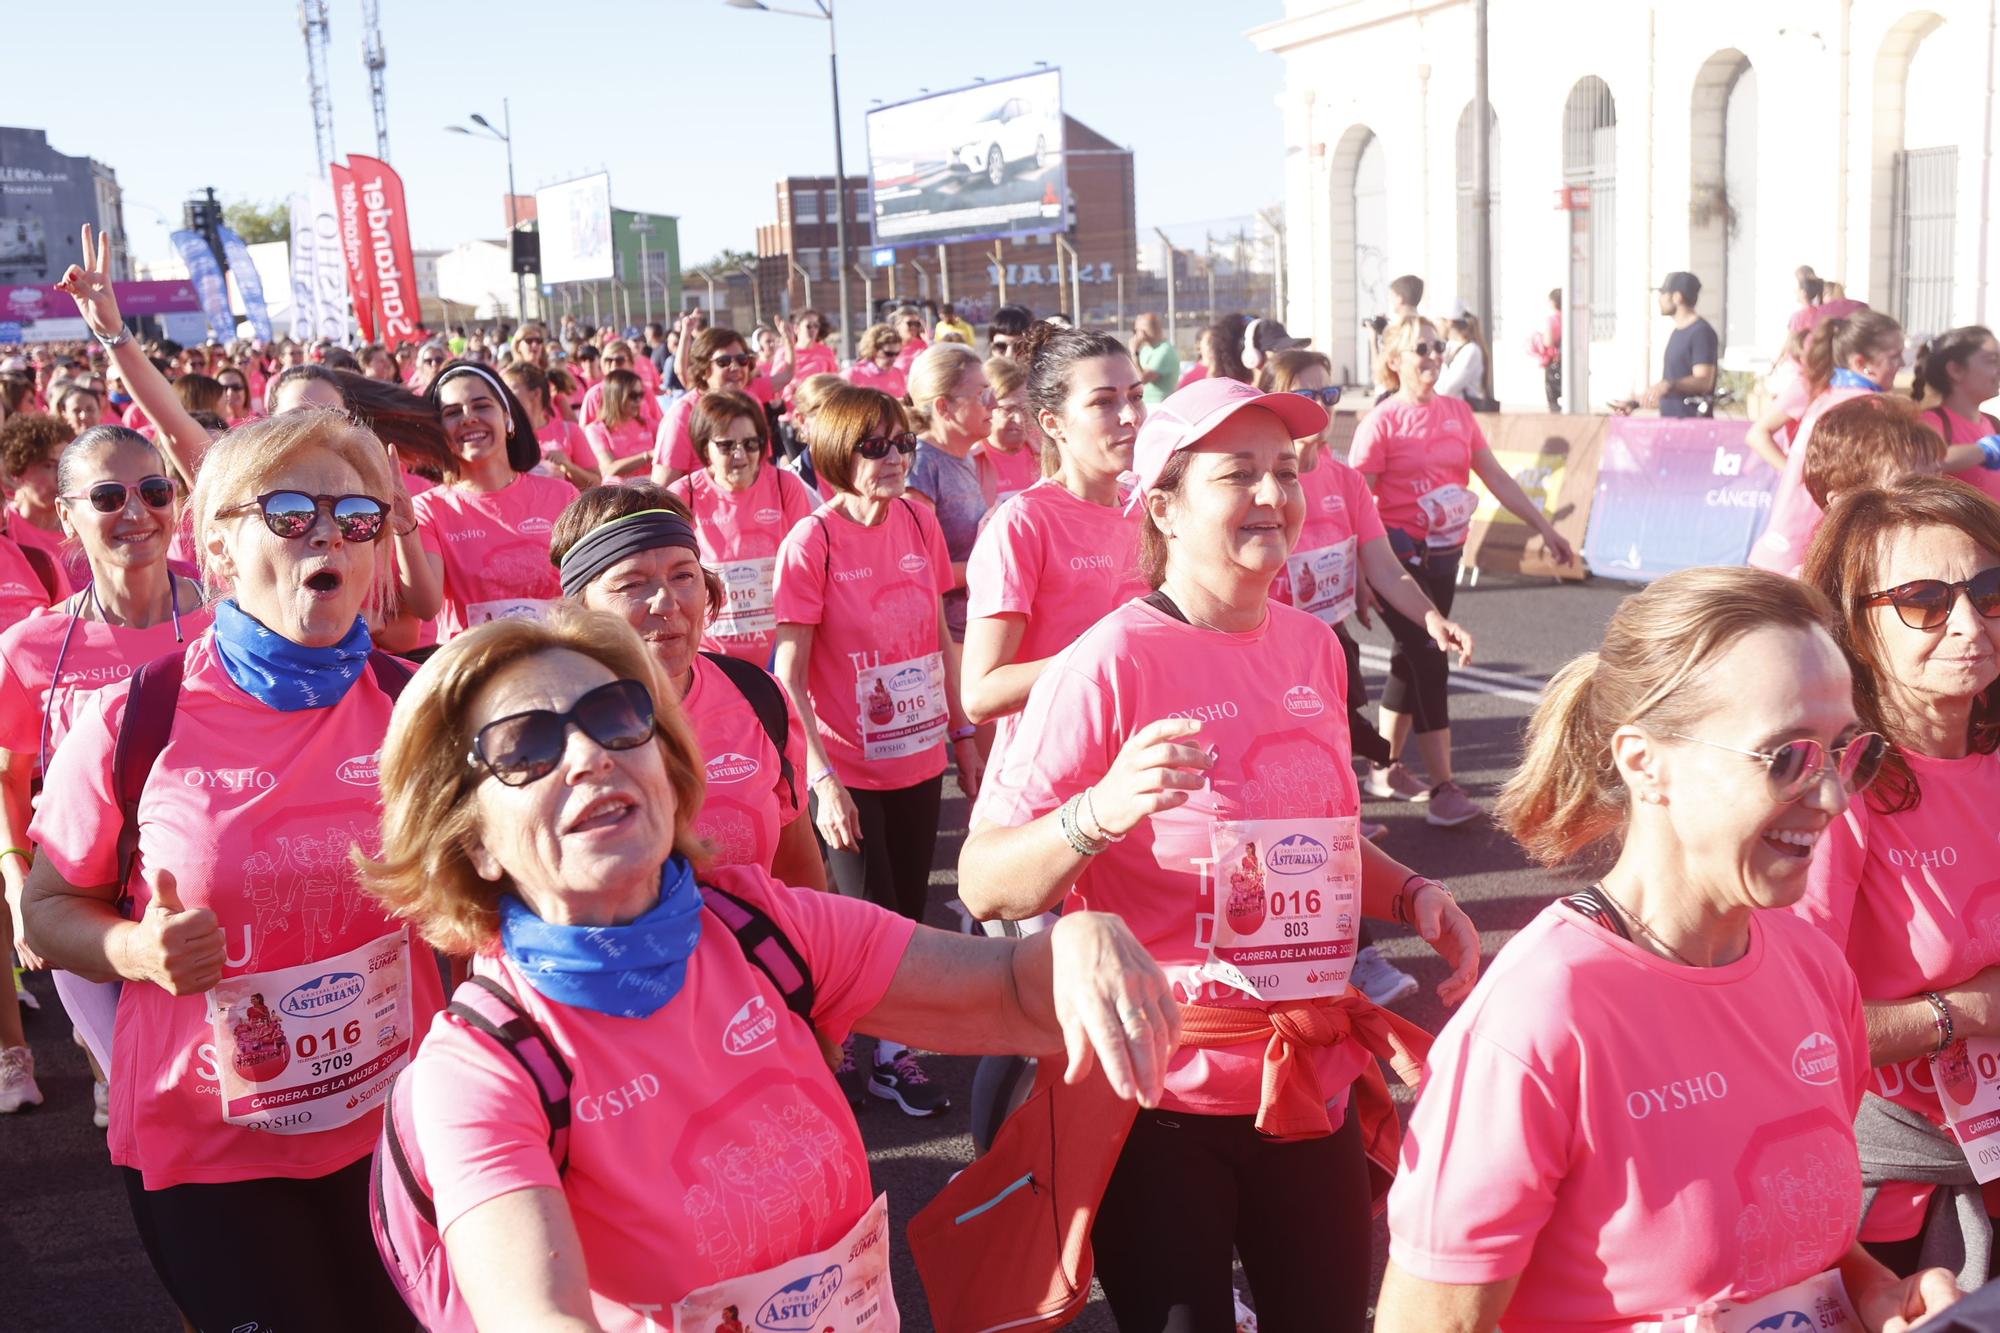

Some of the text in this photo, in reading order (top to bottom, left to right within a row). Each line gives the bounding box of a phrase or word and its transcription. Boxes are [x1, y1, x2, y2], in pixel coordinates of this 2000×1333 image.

[1712, 446, 1742, 476] la
[1070, 556, 1114, 570] OYSHO
[834, 567, 873, 582] OYSHO
[730, 588, 756, 601] 016
[896, 695, 926, 713] 016
[906, 713, 920, 723] 201
[183, 769, 276, 789] OYSHO
[1270, 850, 1323, 867] ASTURIANA
[1270, 889, 1322, 916] 016
[1284, 921, 1309, 938] 803
[368, 953, 398, 974] SUMA
[1233, 949, 1278, 962] CARRERA
[1280, 948, 1294, 959] DE
[1295, 947, 1307, 958] LA
[1308, 945, 1338, 957] MUJER
[287, 983, 361, 1012] ASTURIANA
[295, 1019, 361, 1058] 016
[311, 1052, 353, 1077] 3709
[251, 1087, 310, 1109] CARRERA
[313, 1084, 329, 1096] DE
[331, 1079, 346, 1090] LA
[348, 1062, 379, 1085] MUJER
[1626, 1070, 1728, 1121] OYSHO
[247, 1111, 313, 1132] OYSHO
